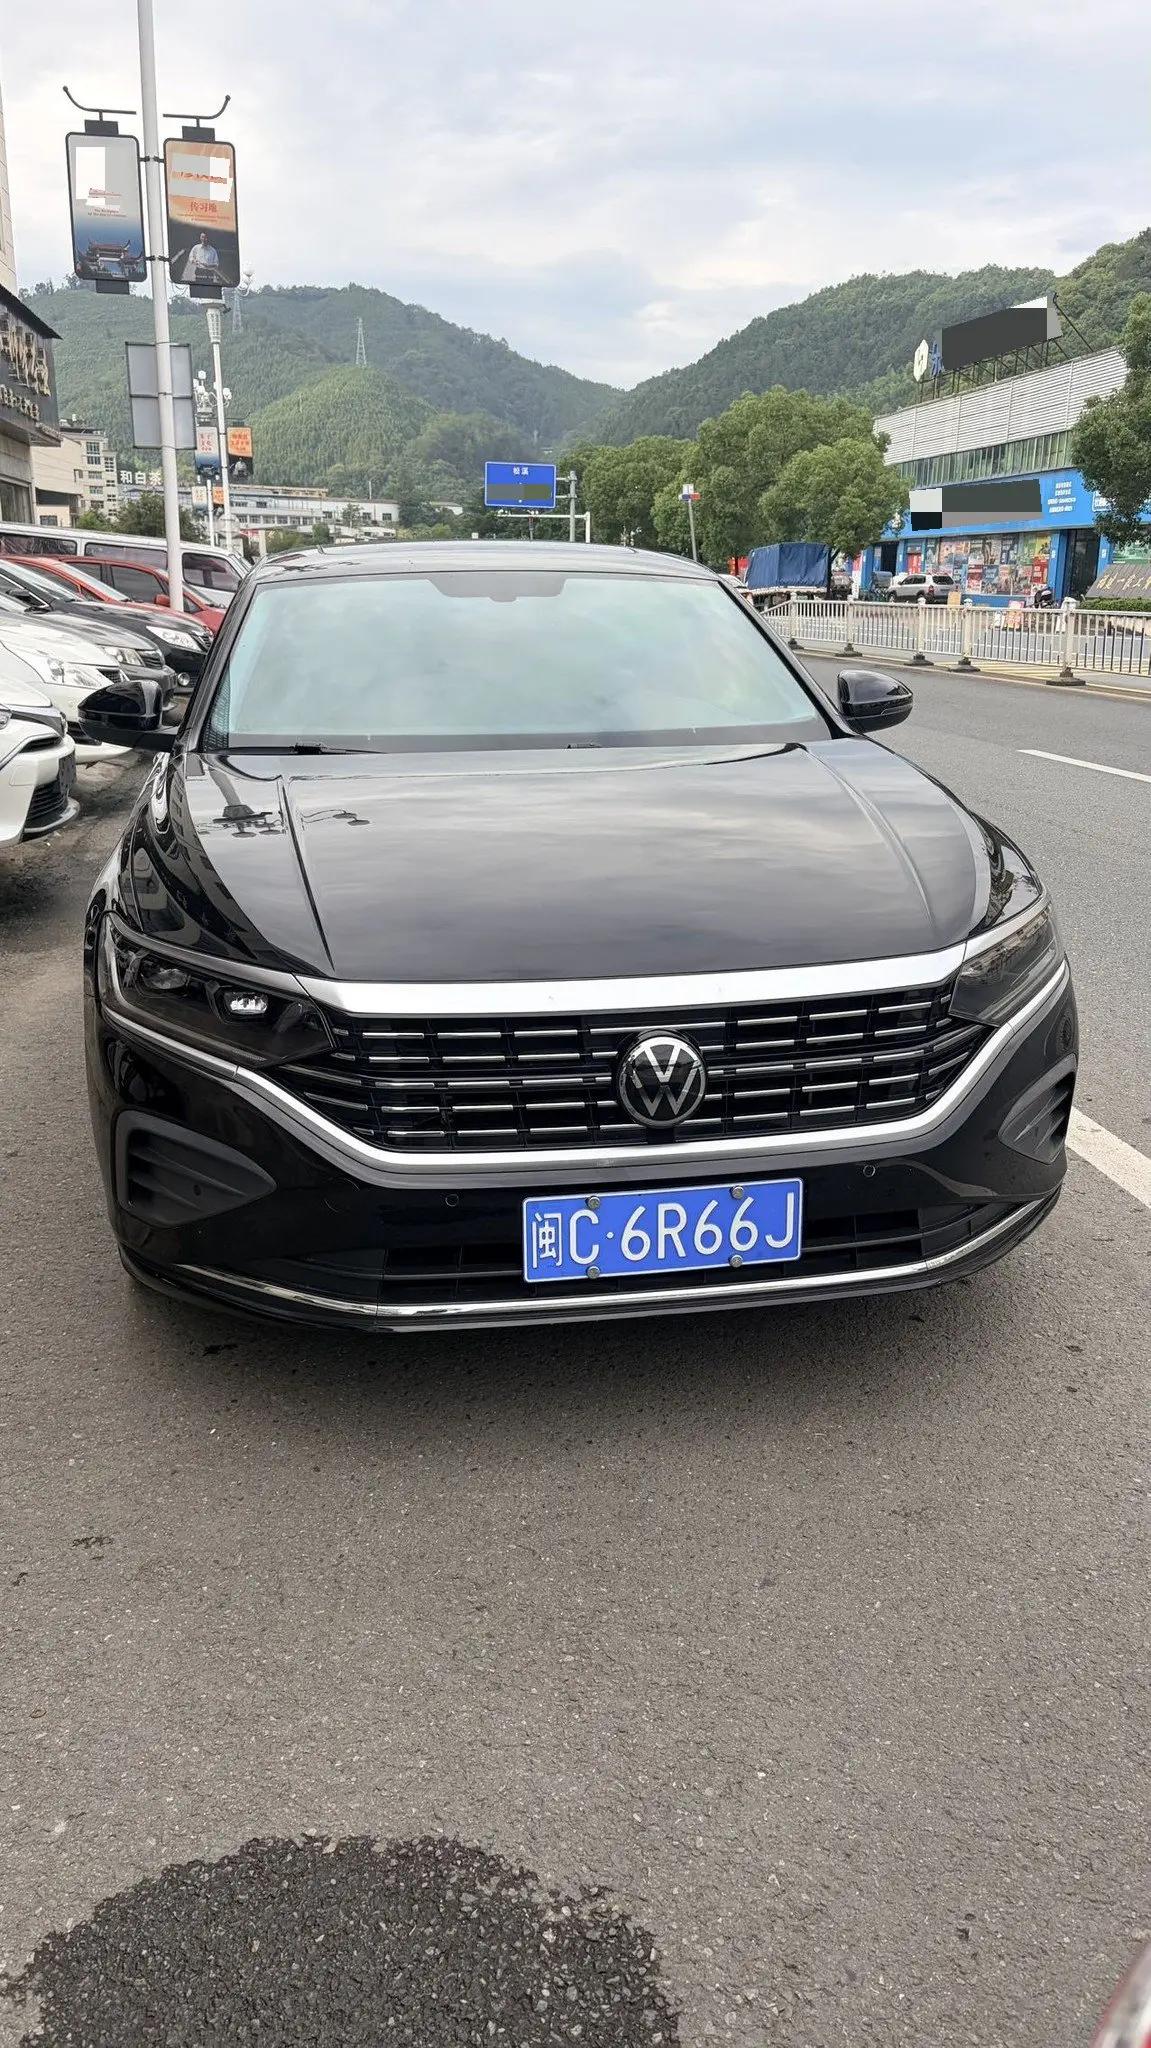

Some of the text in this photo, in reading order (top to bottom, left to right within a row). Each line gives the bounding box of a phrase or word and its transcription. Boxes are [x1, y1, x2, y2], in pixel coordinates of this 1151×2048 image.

[120, 470, 162, 485] 和白茶
[531, 1191, 795, 1269] 闽C·6R66J
